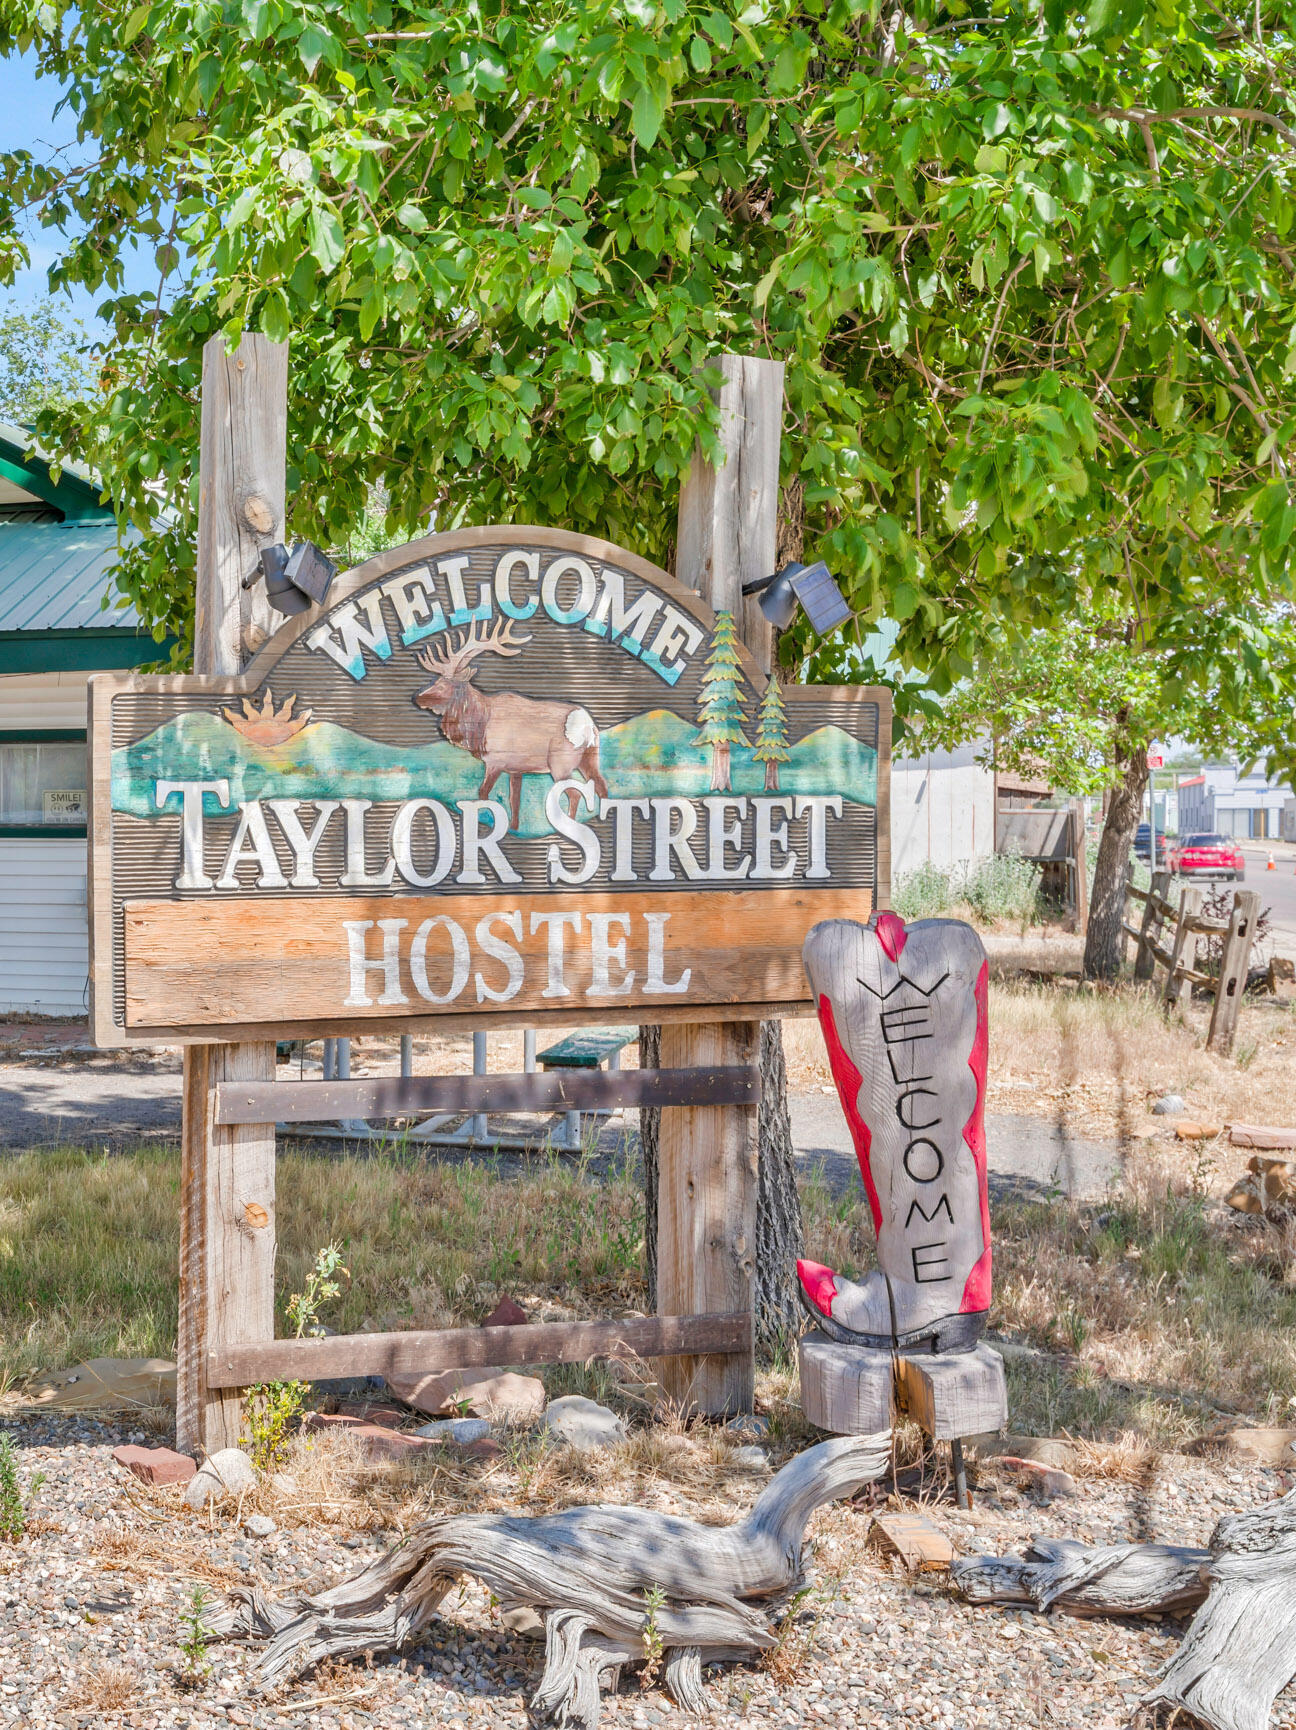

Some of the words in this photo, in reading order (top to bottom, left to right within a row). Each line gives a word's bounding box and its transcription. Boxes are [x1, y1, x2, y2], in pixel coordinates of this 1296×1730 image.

[306, 550, 704, 687] WELCOME
[50, 793, 82, 802] SMILE!
[156, 779, 523, 889] TAYLOR
[545, 779, 843, 884] STREET
[342, 910, 692, 1007] HOSTEL
[856, 972, 955, 1283] WELCOME
